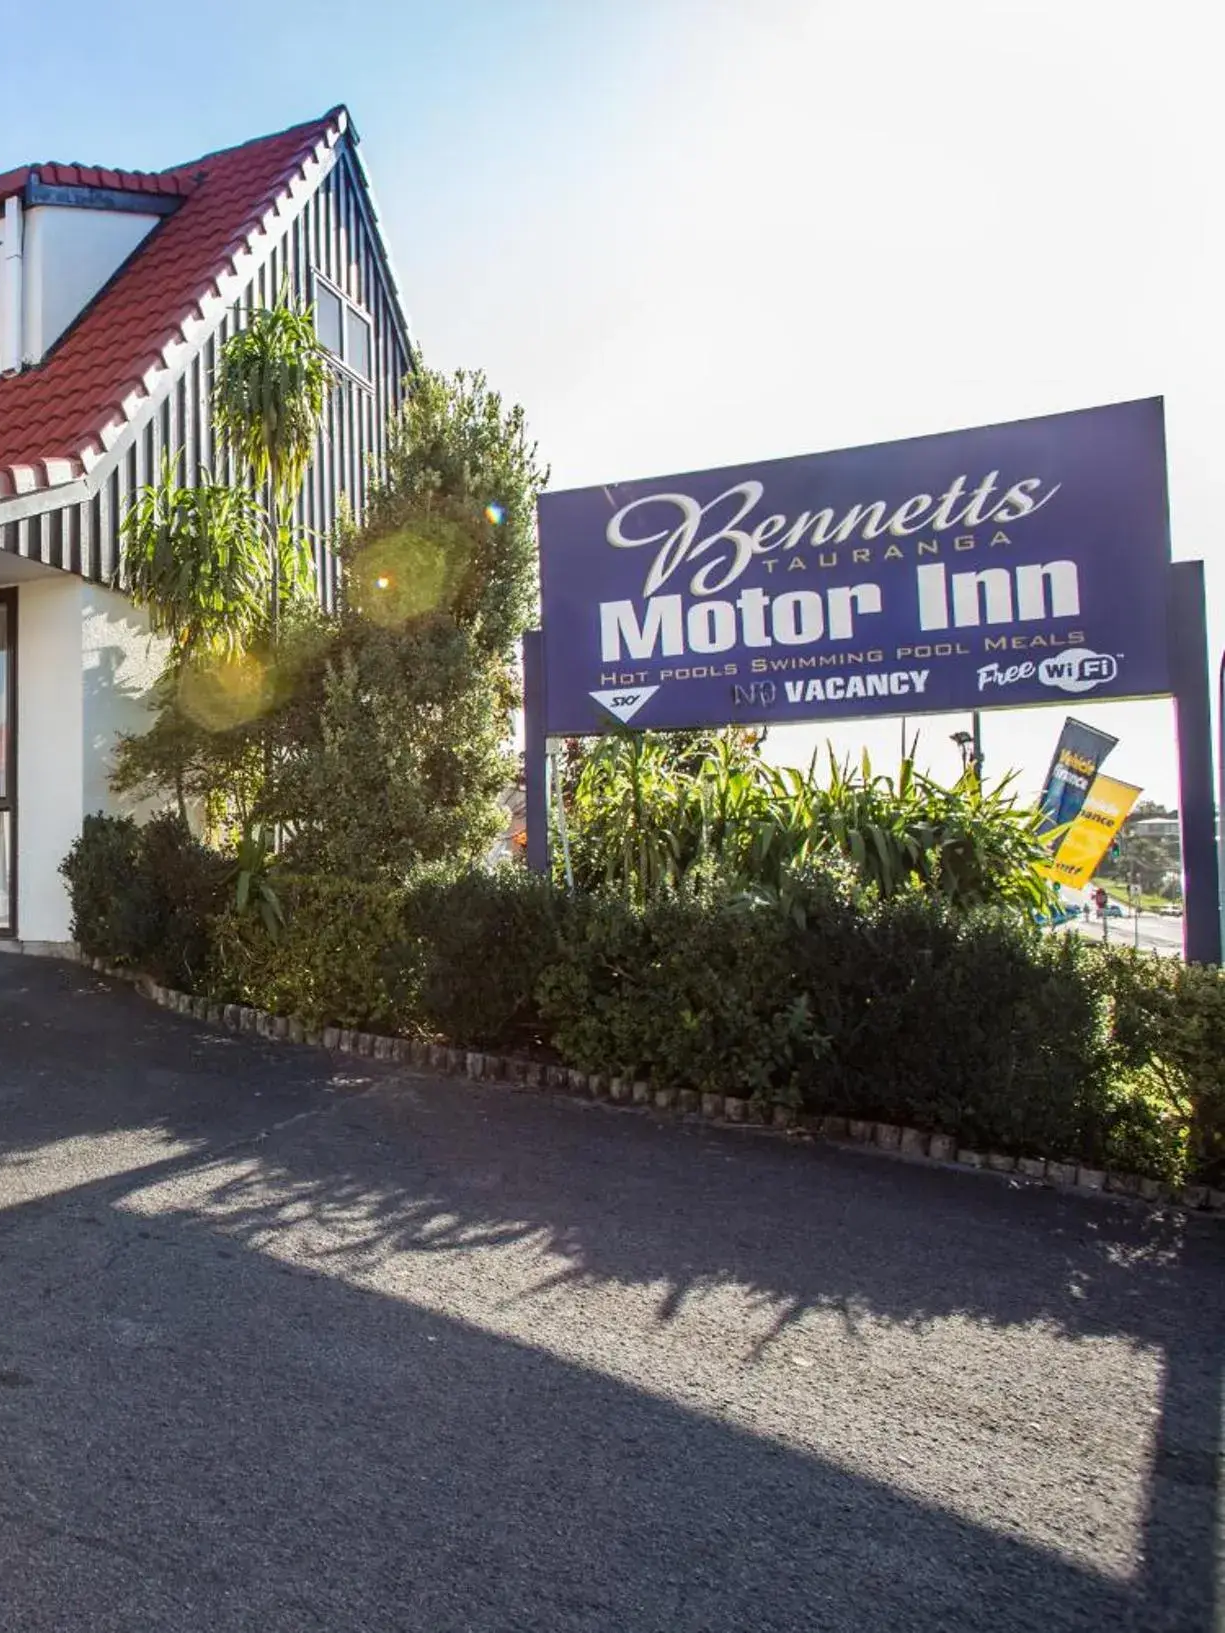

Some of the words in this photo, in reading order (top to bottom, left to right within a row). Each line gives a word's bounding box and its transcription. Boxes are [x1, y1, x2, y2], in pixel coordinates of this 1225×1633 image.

[605, 470, 1061, 598] Bennetts
[762, 531, 1012, 573] TAURANGA
[599, 582, 882, 662] Motor
[917, 559, 1080, 631] Inn
[784, 670, 930, 702] VACANCY
[977, 661, 1036, 691] Free
